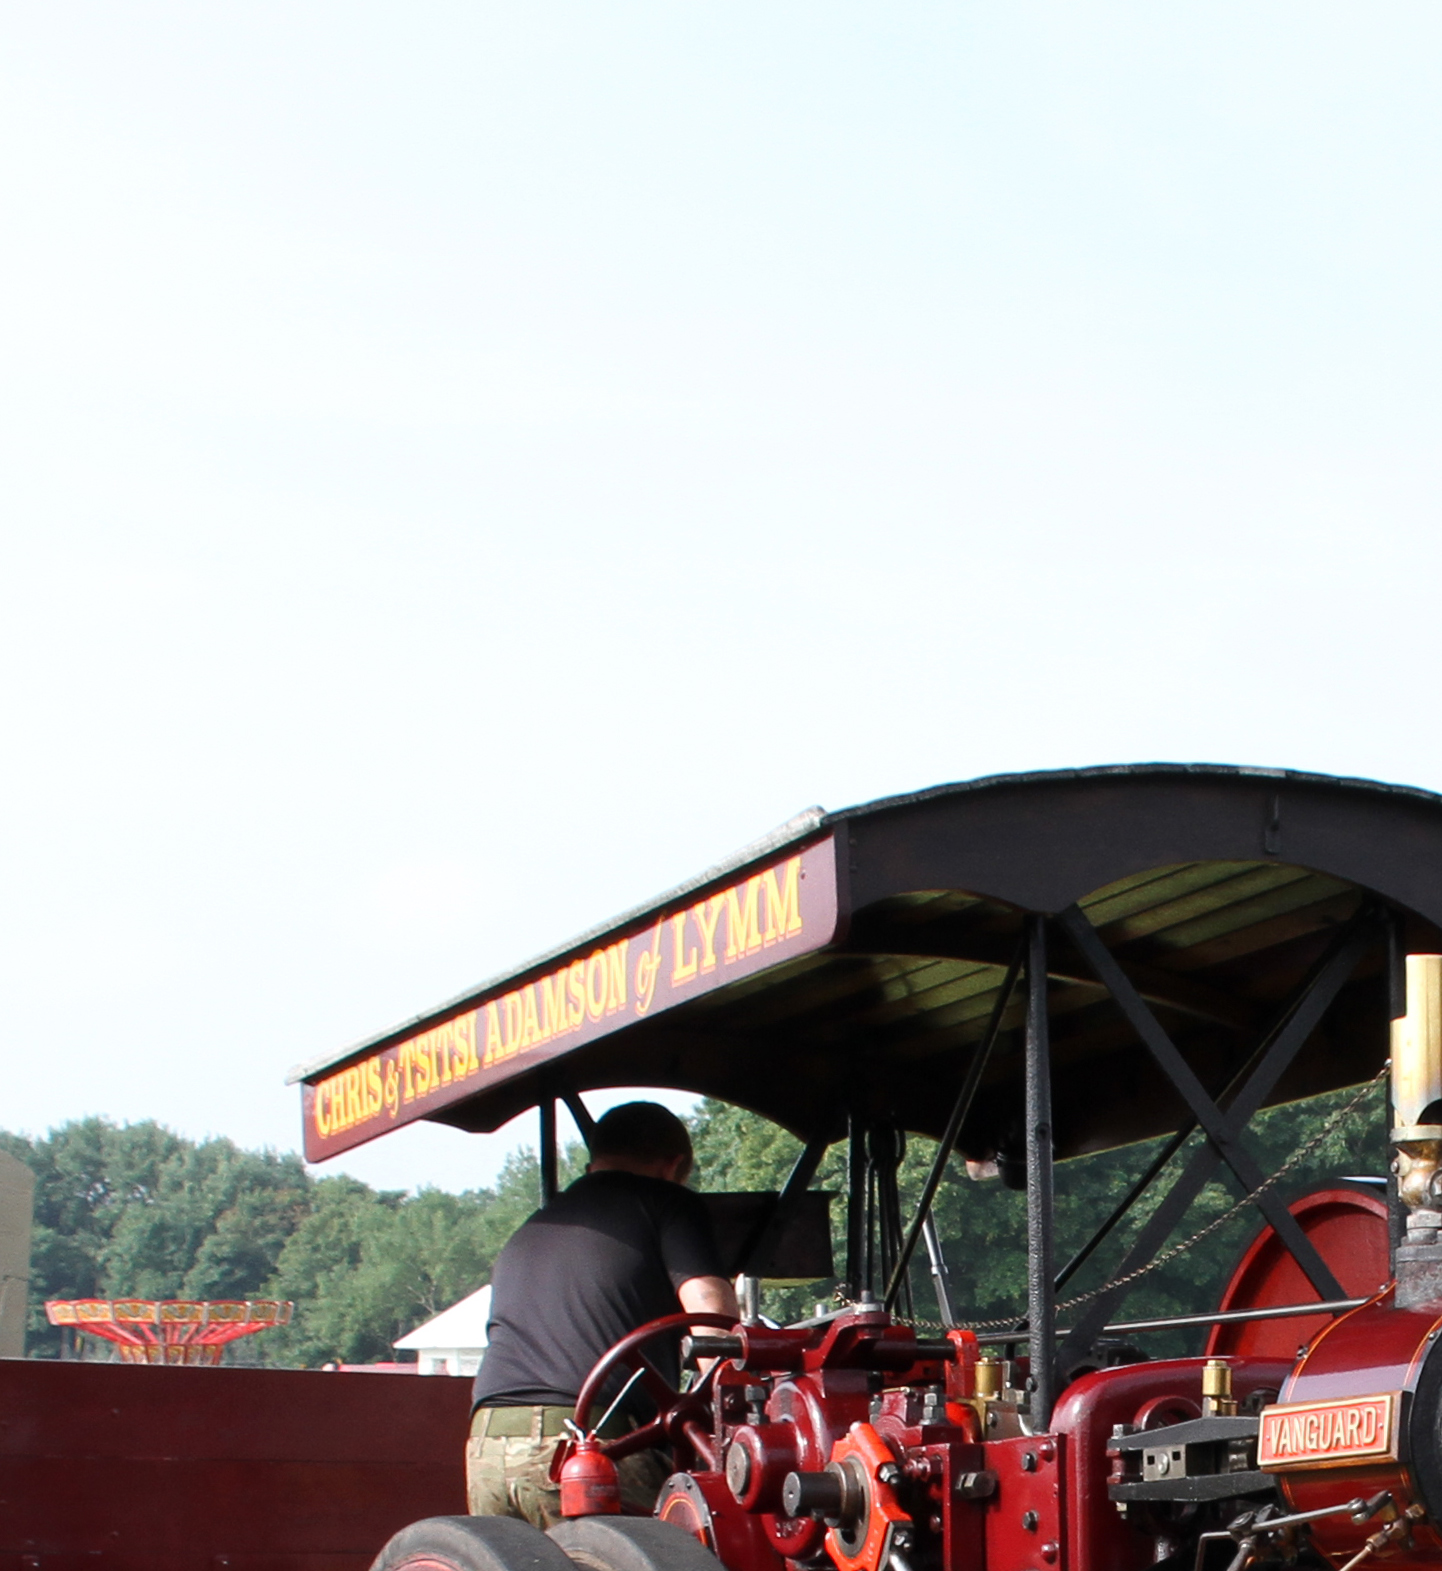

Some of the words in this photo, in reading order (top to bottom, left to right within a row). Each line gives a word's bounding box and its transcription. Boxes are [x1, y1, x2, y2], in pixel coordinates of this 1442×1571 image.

[314, 1053, 383, 1139] CHRIS
[383, 1058, 400, 1119] &
[399, 1009, 479, 1103] TSITSI
[484, 940, 628, 1067] ADAMSON
[635, 912, 662, 1015] of
[671, 857, 802, 986] LYMM
[1271, 1407, 1377, 1454] VANGUARD
